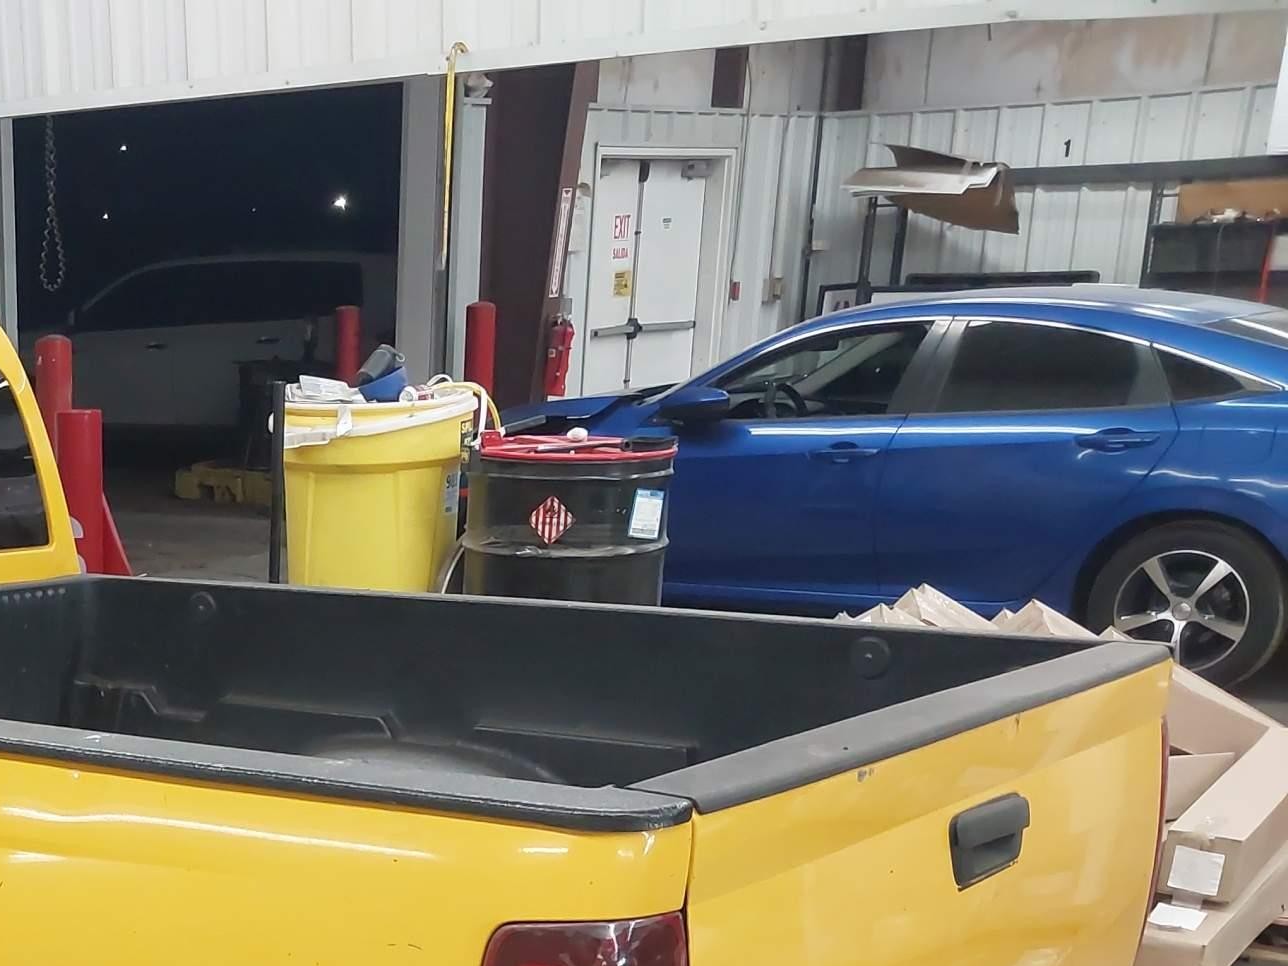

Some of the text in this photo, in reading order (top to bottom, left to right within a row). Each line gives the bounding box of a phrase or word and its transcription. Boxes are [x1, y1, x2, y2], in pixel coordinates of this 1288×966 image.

[1064, 139, 1071, 158] 1
[614, 214, 631, 240] EXIT
[612, 247, 629, 260] SALIDA
